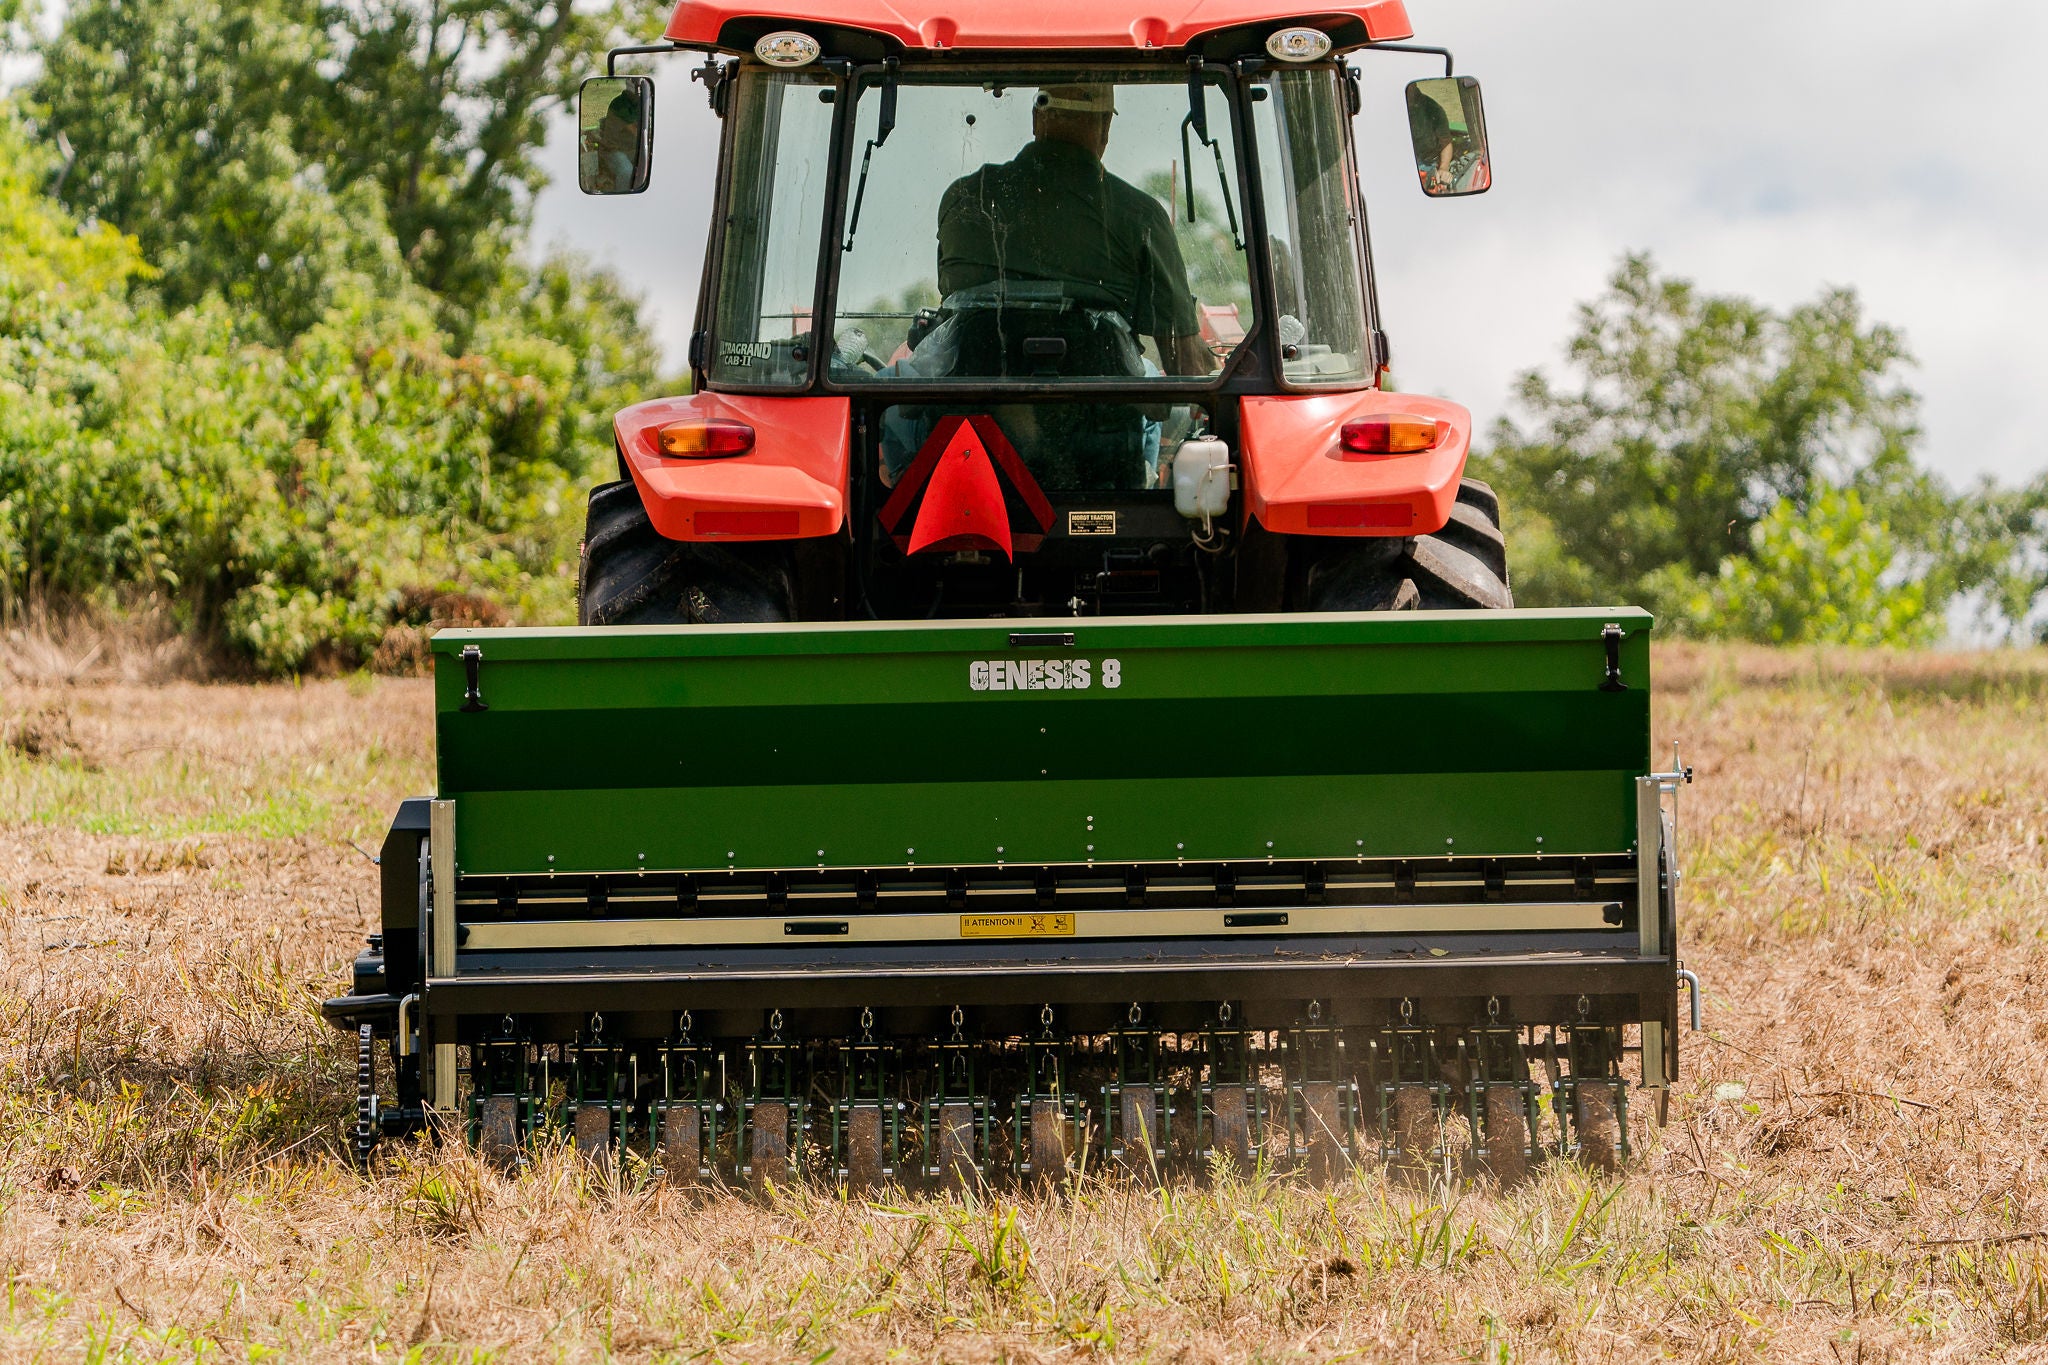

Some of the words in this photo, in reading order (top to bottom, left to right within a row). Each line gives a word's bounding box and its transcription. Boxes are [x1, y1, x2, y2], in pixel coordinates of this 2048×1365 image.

[969, 659, 1091, 691] GENESIS
[1101, 658, 1121, 689] 8
[971, 918, 1016, 927] ATTENTION
